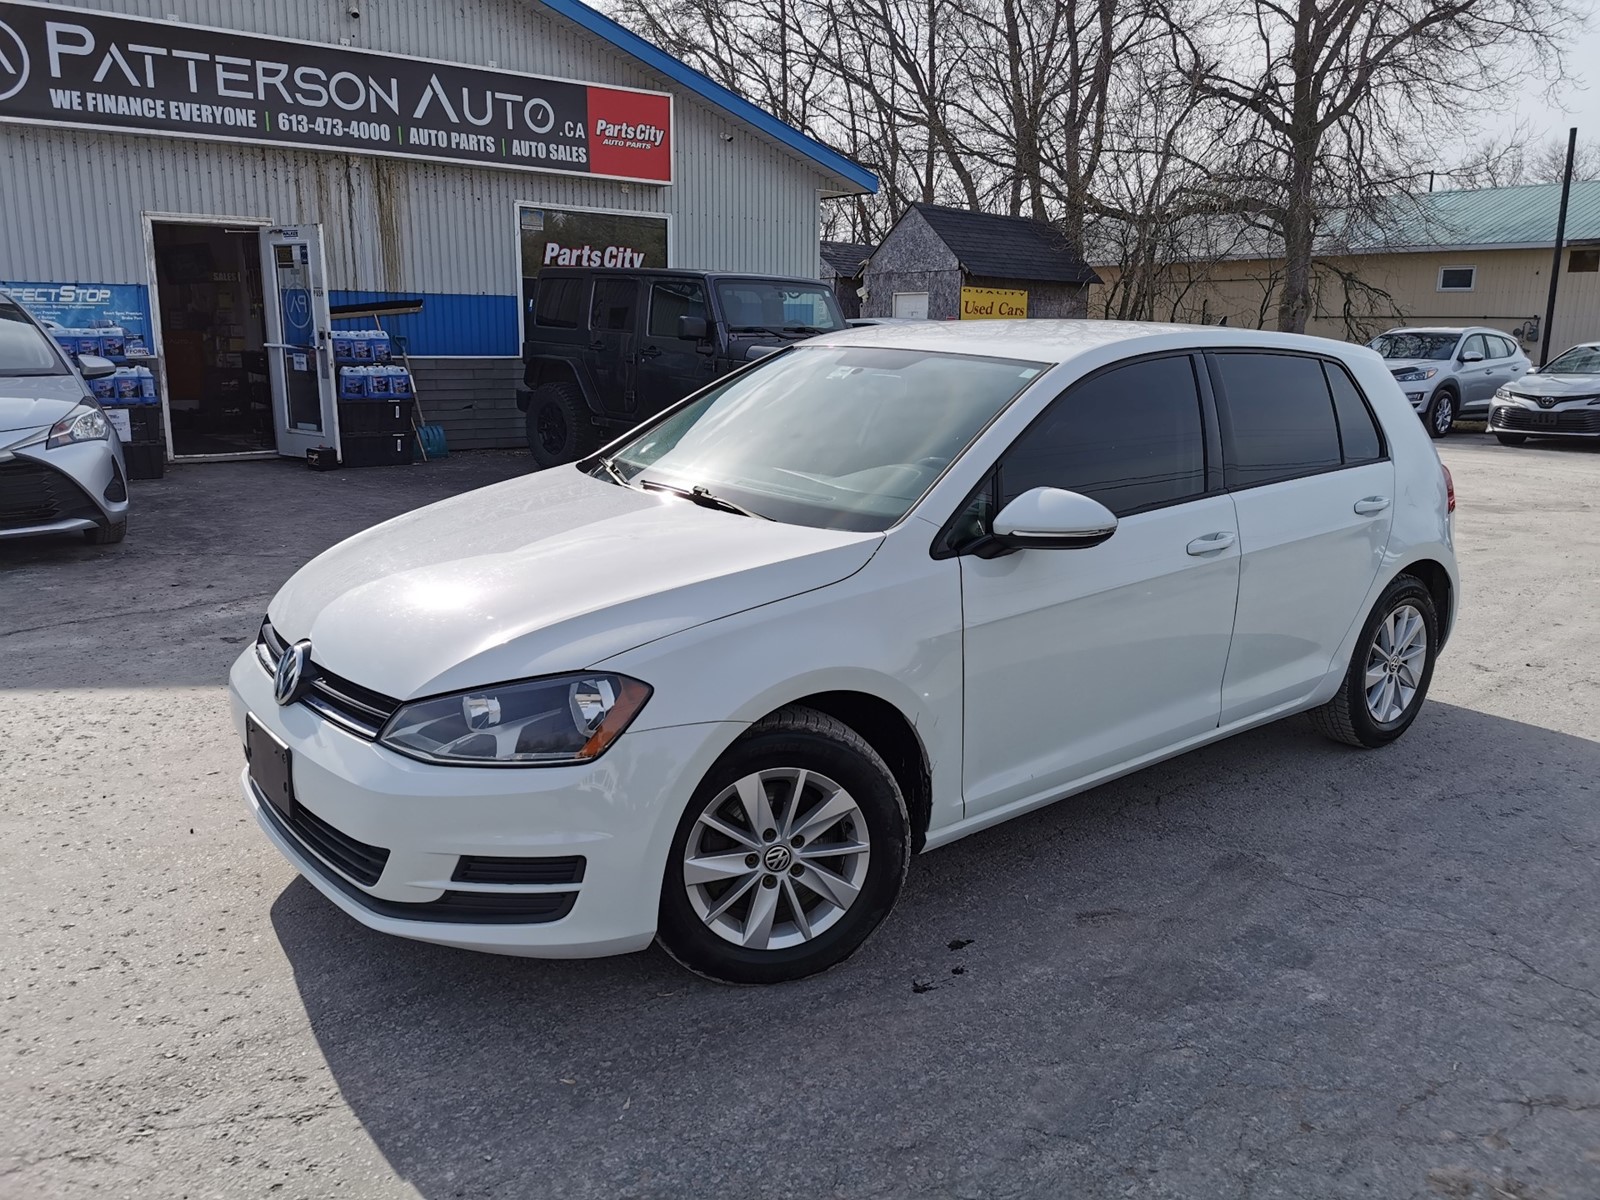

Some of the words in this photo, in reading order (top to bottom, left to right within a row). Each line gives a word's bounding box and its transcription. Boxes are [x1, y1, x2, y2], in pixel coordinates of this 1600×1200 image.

[46, 21, 399, 116] PATTERSON
[49, 88, 84, 110] WE
[86, 92, 166, 120] FINANCE
[169, 100, 258, 128] EVERYONE
[278, 112, 391, 142] 613-473-4000
[409, 127, 448, 149] AUTO
[450, 131, 496, 153] PARTS
[512, 139, 547, 160] AUTO
[549, 143, 588, 164] SALES
[602, 138, 624, 147] AUTO
[626, 141, 652, 150] PARTS
[213, 272, 237, 281] SALES
[963, 288, 1027, 296] QUALITY
[964, 300, 994, 315] Used
[998, 301, 1025, 316] Cars
